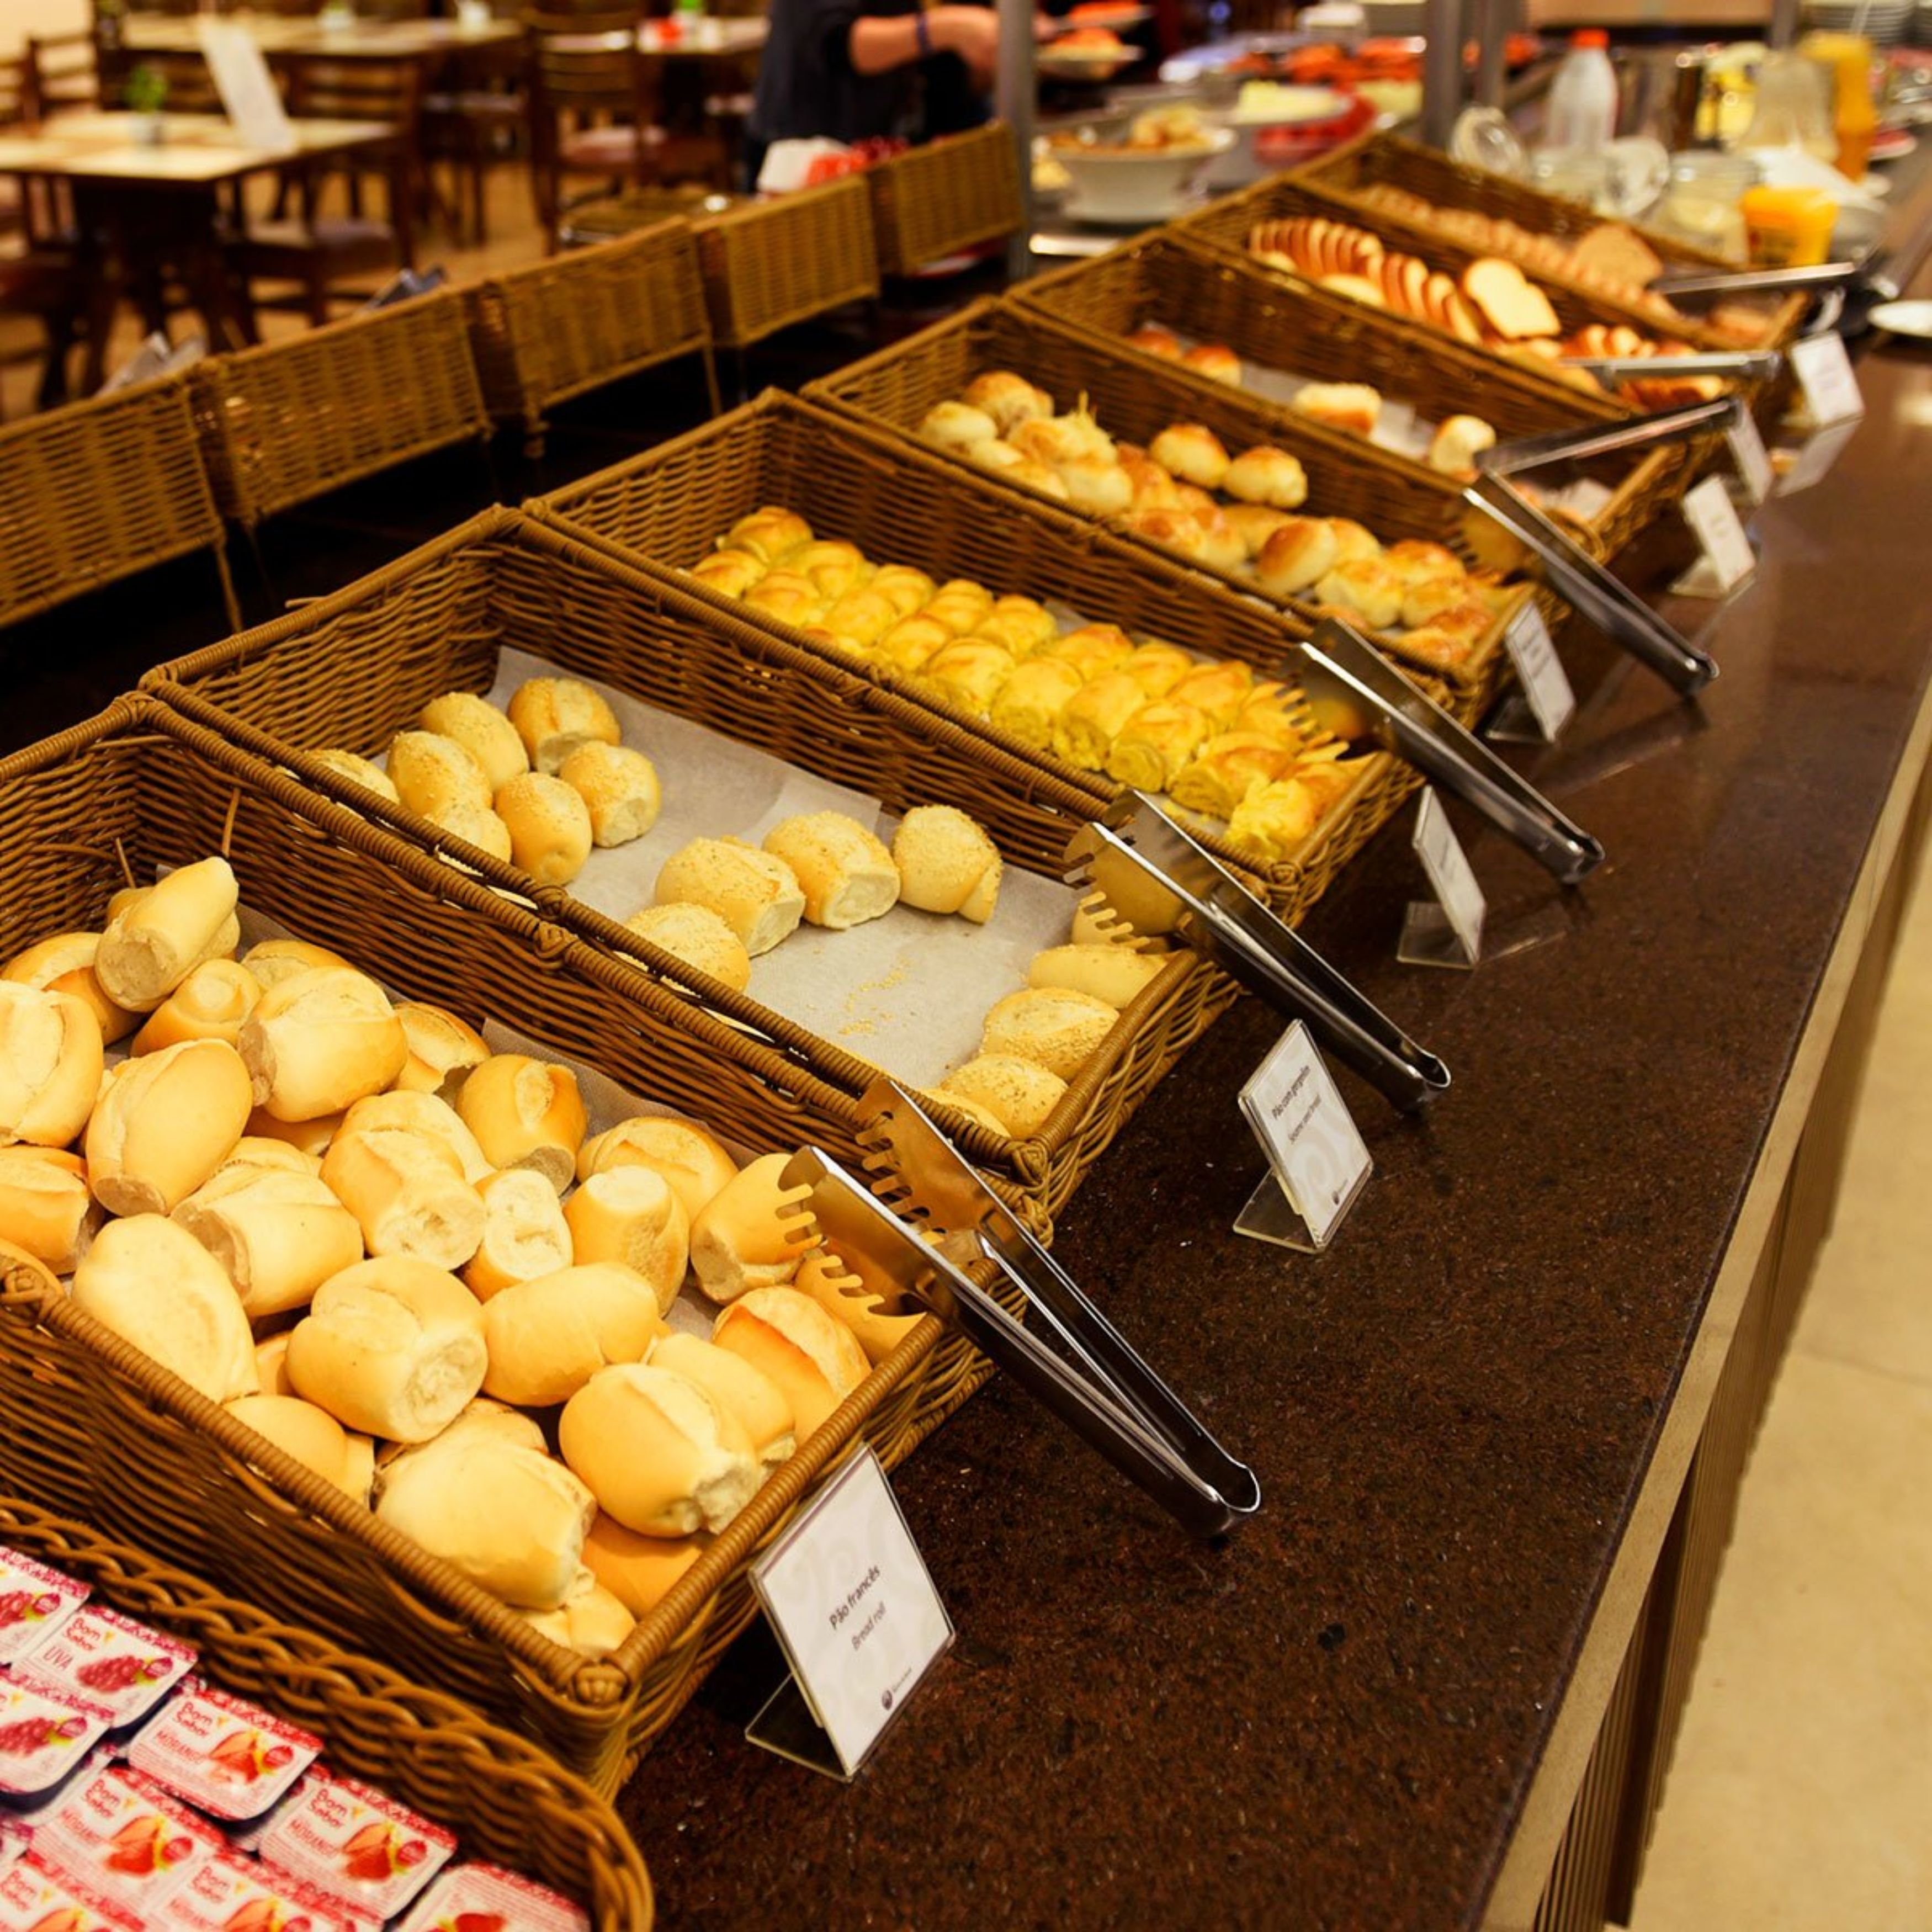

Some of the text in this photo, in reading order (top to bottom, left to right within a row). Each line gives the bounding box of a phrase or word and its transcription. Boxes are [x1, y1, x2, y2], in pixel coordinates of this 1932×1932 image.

[829, 1565, 880, 1630] Pão francês
[852, 1616, 874, 1650] Bread
[43, 1646, 73, 1670] UVA
